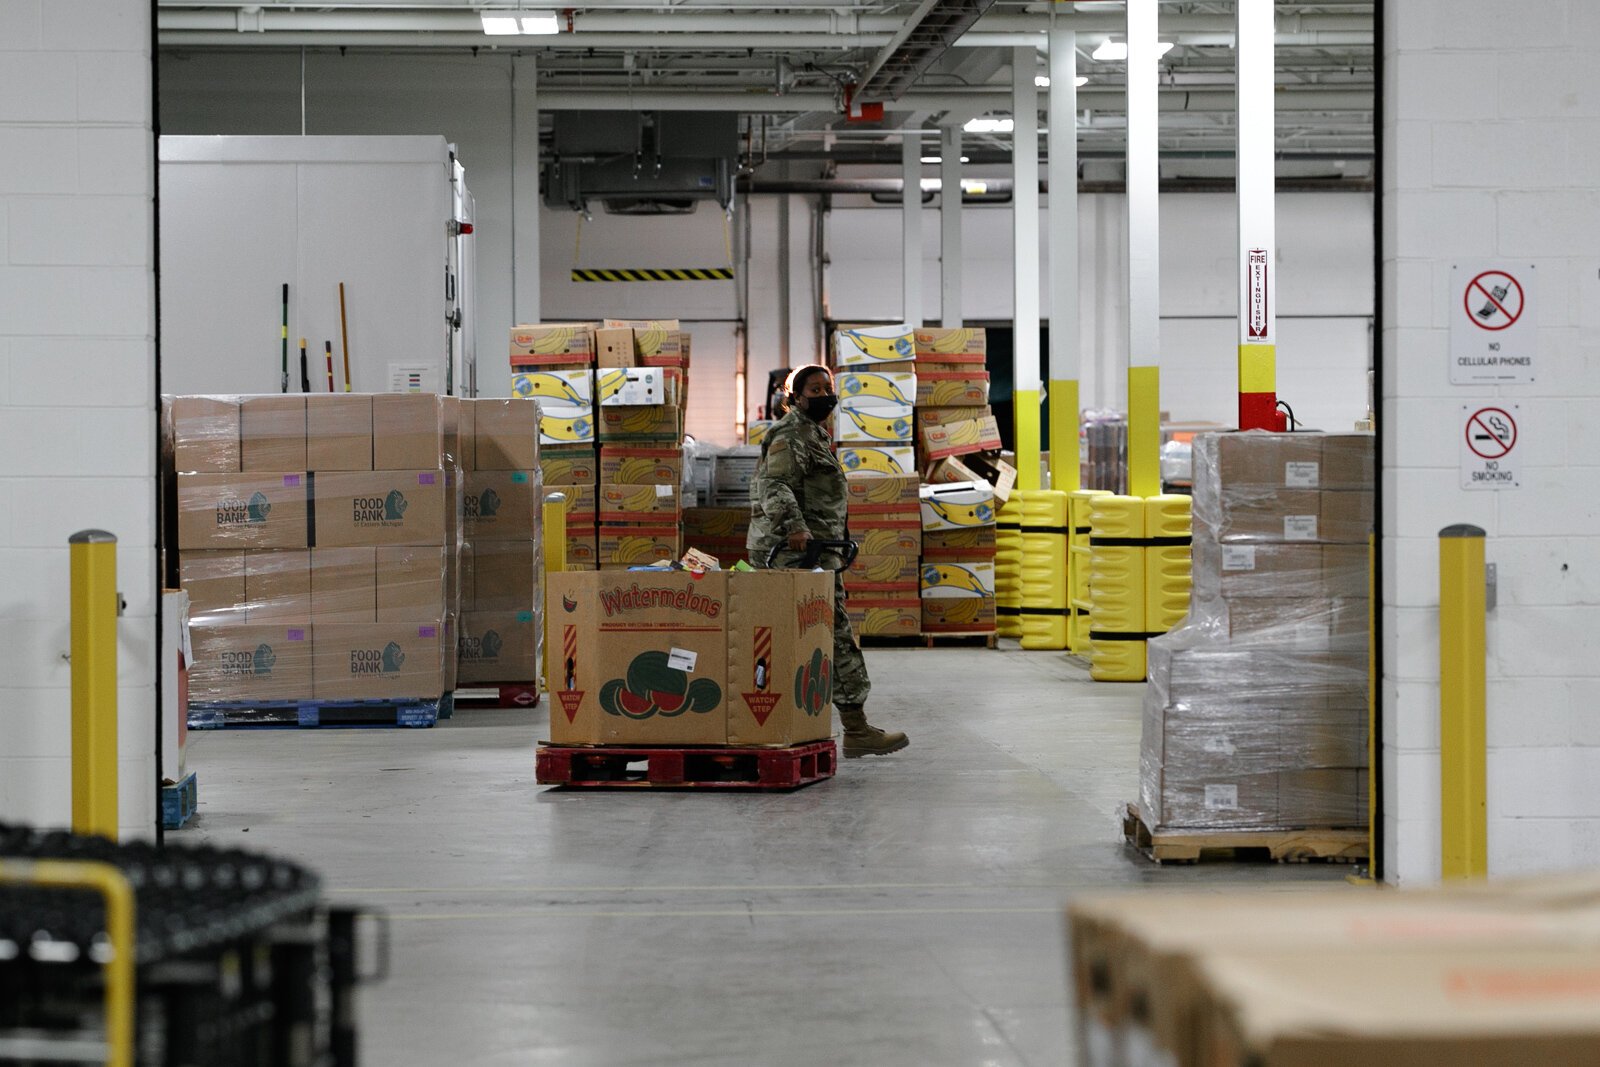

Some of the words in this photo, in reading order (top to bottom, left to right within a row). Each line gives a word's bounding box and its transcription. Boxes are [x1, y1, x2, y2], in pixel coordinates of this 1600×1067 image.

[1250, 255, 1266, 263] FIRE
[1488, 342, 1501, 352] NO
[1457, 356, 1498, 367] CELLULAR
[1499, 356, 1532, 367] PHONES
[1485, 460, 1499, 471] NO
[1471, 471, 1513, 482] SMOKING
[216, 500, 247, 511] FOOD
[353, 498, 384, 510] FOOD
[464, 495, 479, 506] OD
[353, 510, 384, 521] BANK
[464, 506, 479, 517] NK
[216, 512, 248, 524] BANK
[600, 582, 722, 618] Watermelons
[458, 637, 480, 648] OOD
[221, 651, 252, 662] FOOD
[351, 650, 381, 661] FOOD
[459, 648, 480, 658] ANK
[221, 663, 253, 674] BANK
[351, 662, 381, 673] BANK
